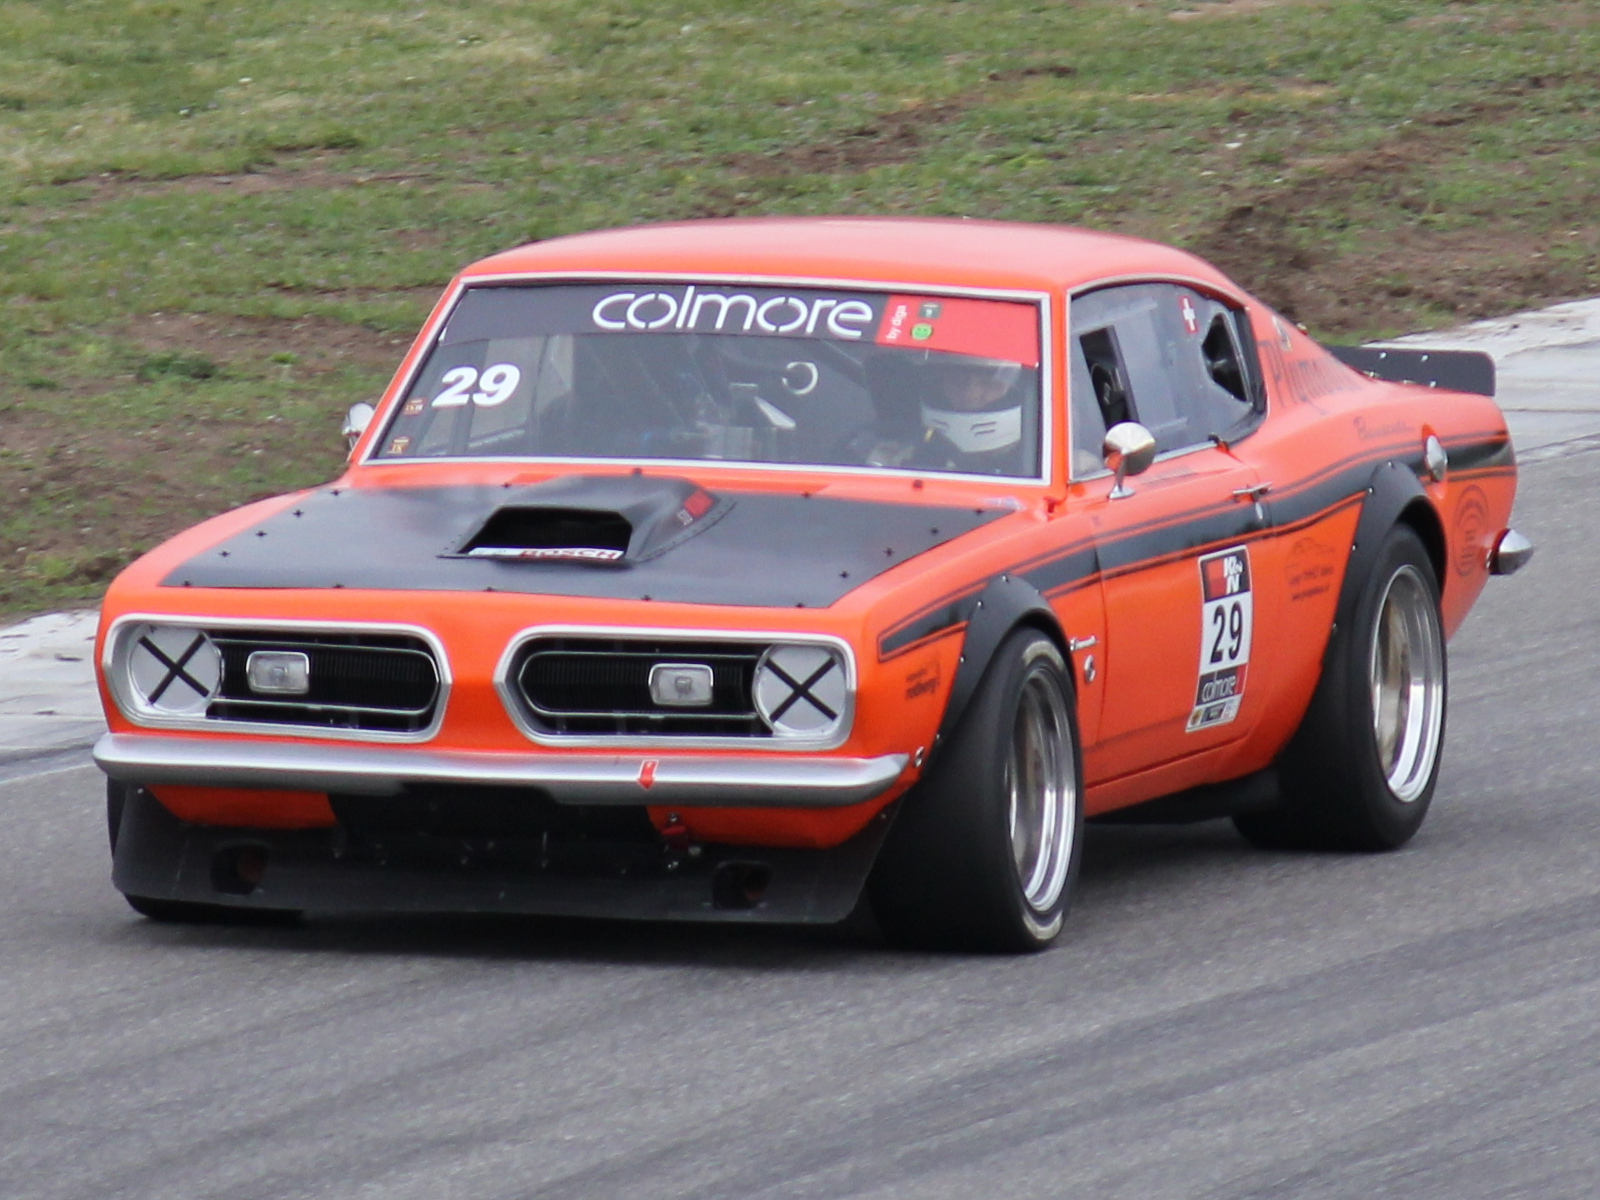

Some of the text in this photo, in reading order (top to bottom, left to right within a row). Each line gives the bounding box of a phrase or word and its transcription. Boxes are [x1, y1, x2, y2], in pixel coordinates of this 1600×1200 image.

[592, 285, 874, 338] colmore
[431, 363, 521, 407] 29
[1209, 600, 1243, 664] 29
[1201, 670, 1237, 702] colmore
